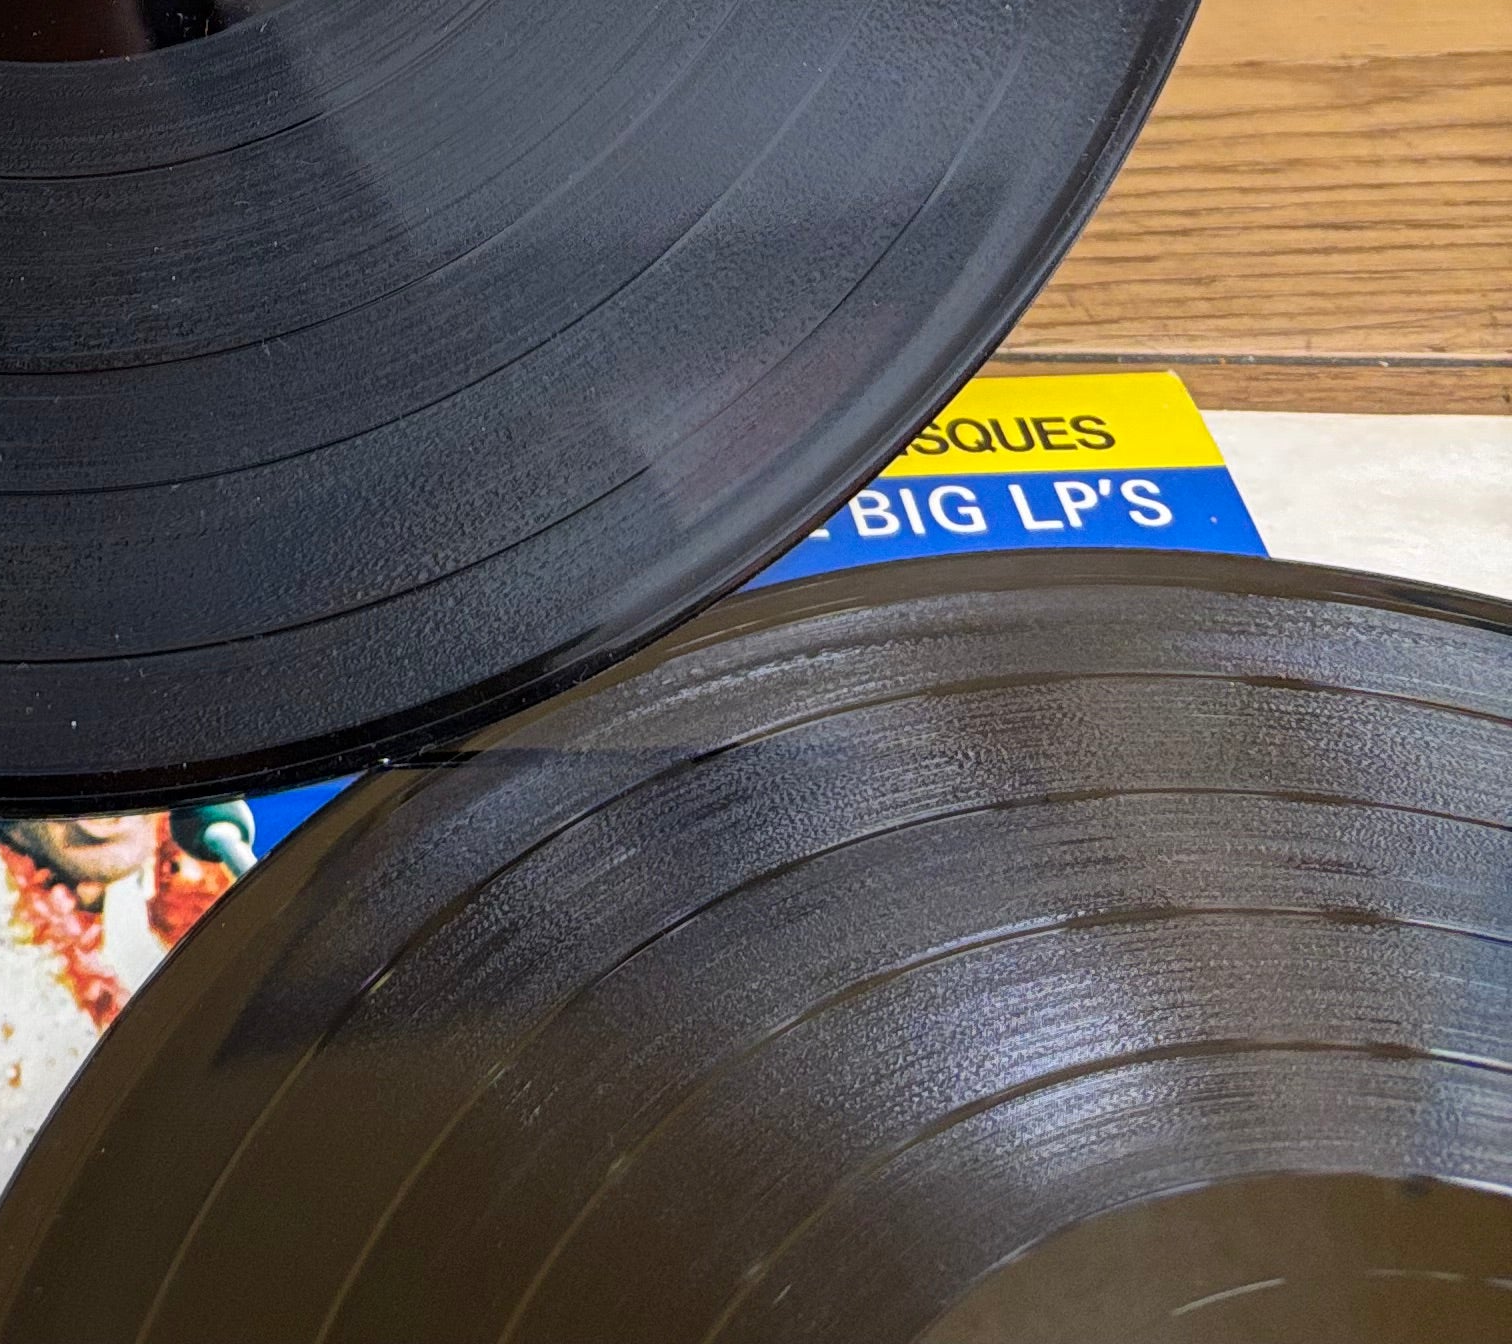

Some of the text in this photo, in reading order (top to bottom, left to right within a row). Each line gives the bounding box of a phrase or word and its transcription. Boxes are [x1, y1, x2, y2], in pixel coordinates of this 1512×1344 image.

[900, 415, 1116, 456] SQUES
[848, 478, 1173, 537] BIG LP'S
